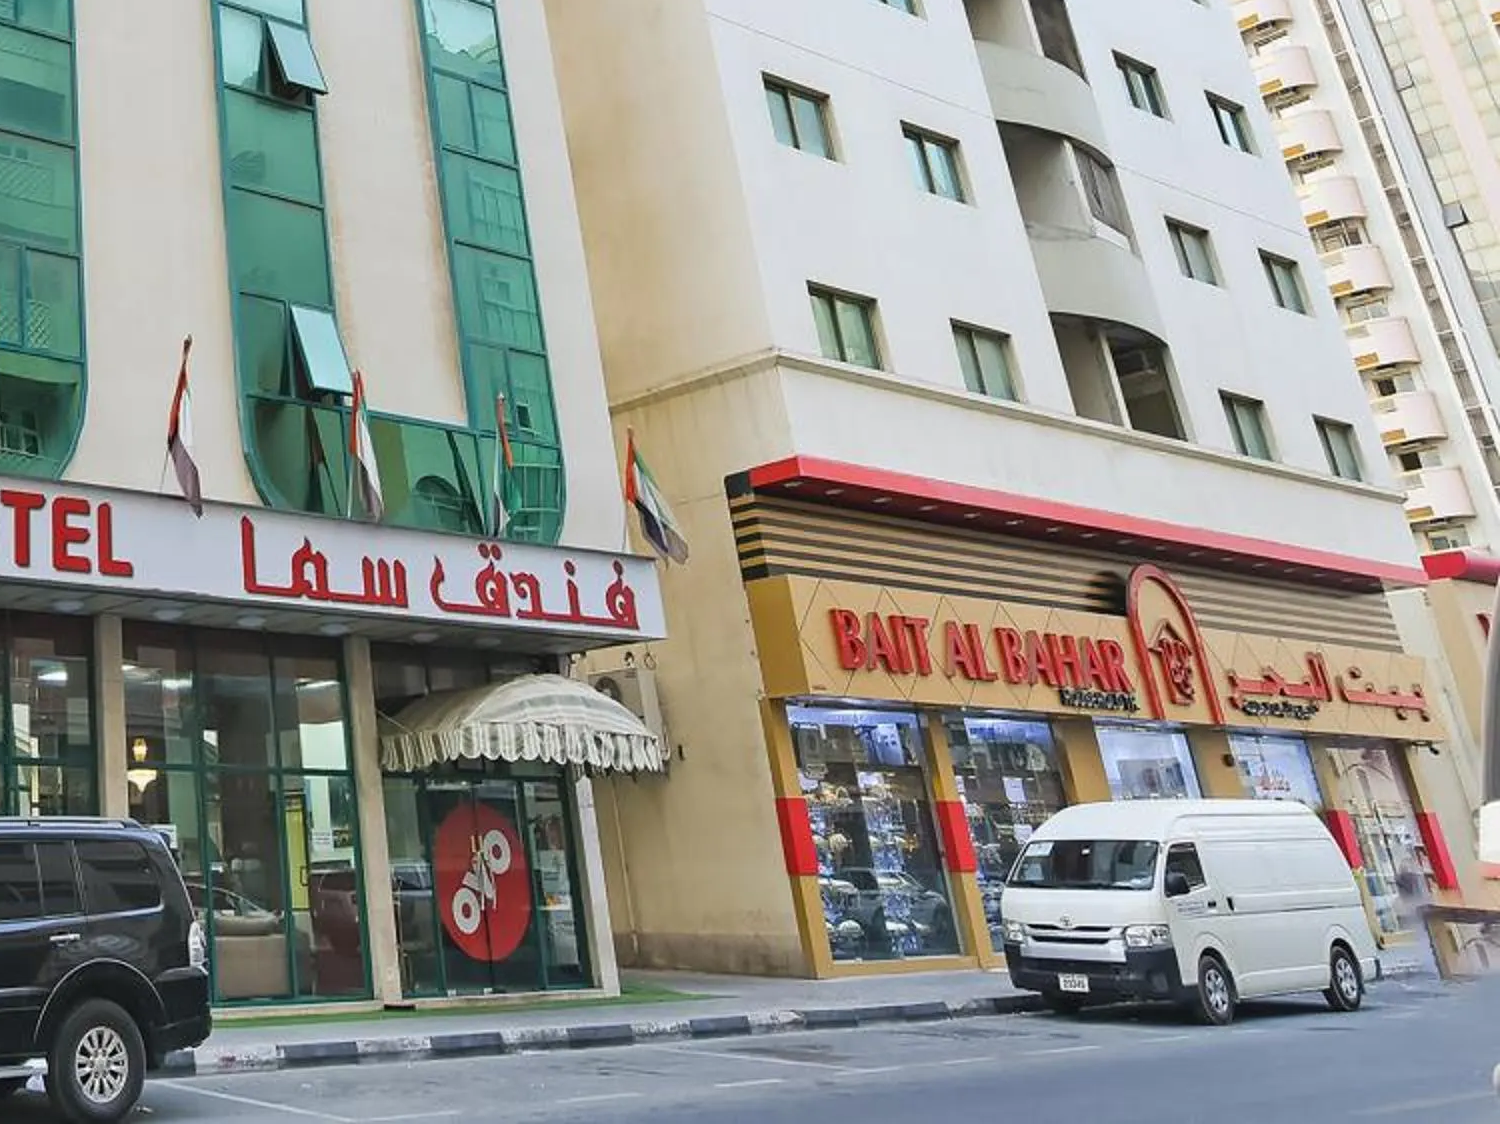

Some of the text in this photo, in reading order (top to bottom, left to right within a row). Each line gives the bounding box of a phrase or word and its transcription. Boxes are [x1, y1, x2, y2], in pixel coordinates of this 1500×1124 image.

[240, 515, 640, 631] فندق سما
[830, 609, 933, 676] BAIT
[944, 620, 998, 682] AL
[995, 626, 1137, 693] BAHAR
[1336, 665, 1431, 723] بيت
[452, 829, 512, 935] OYO
